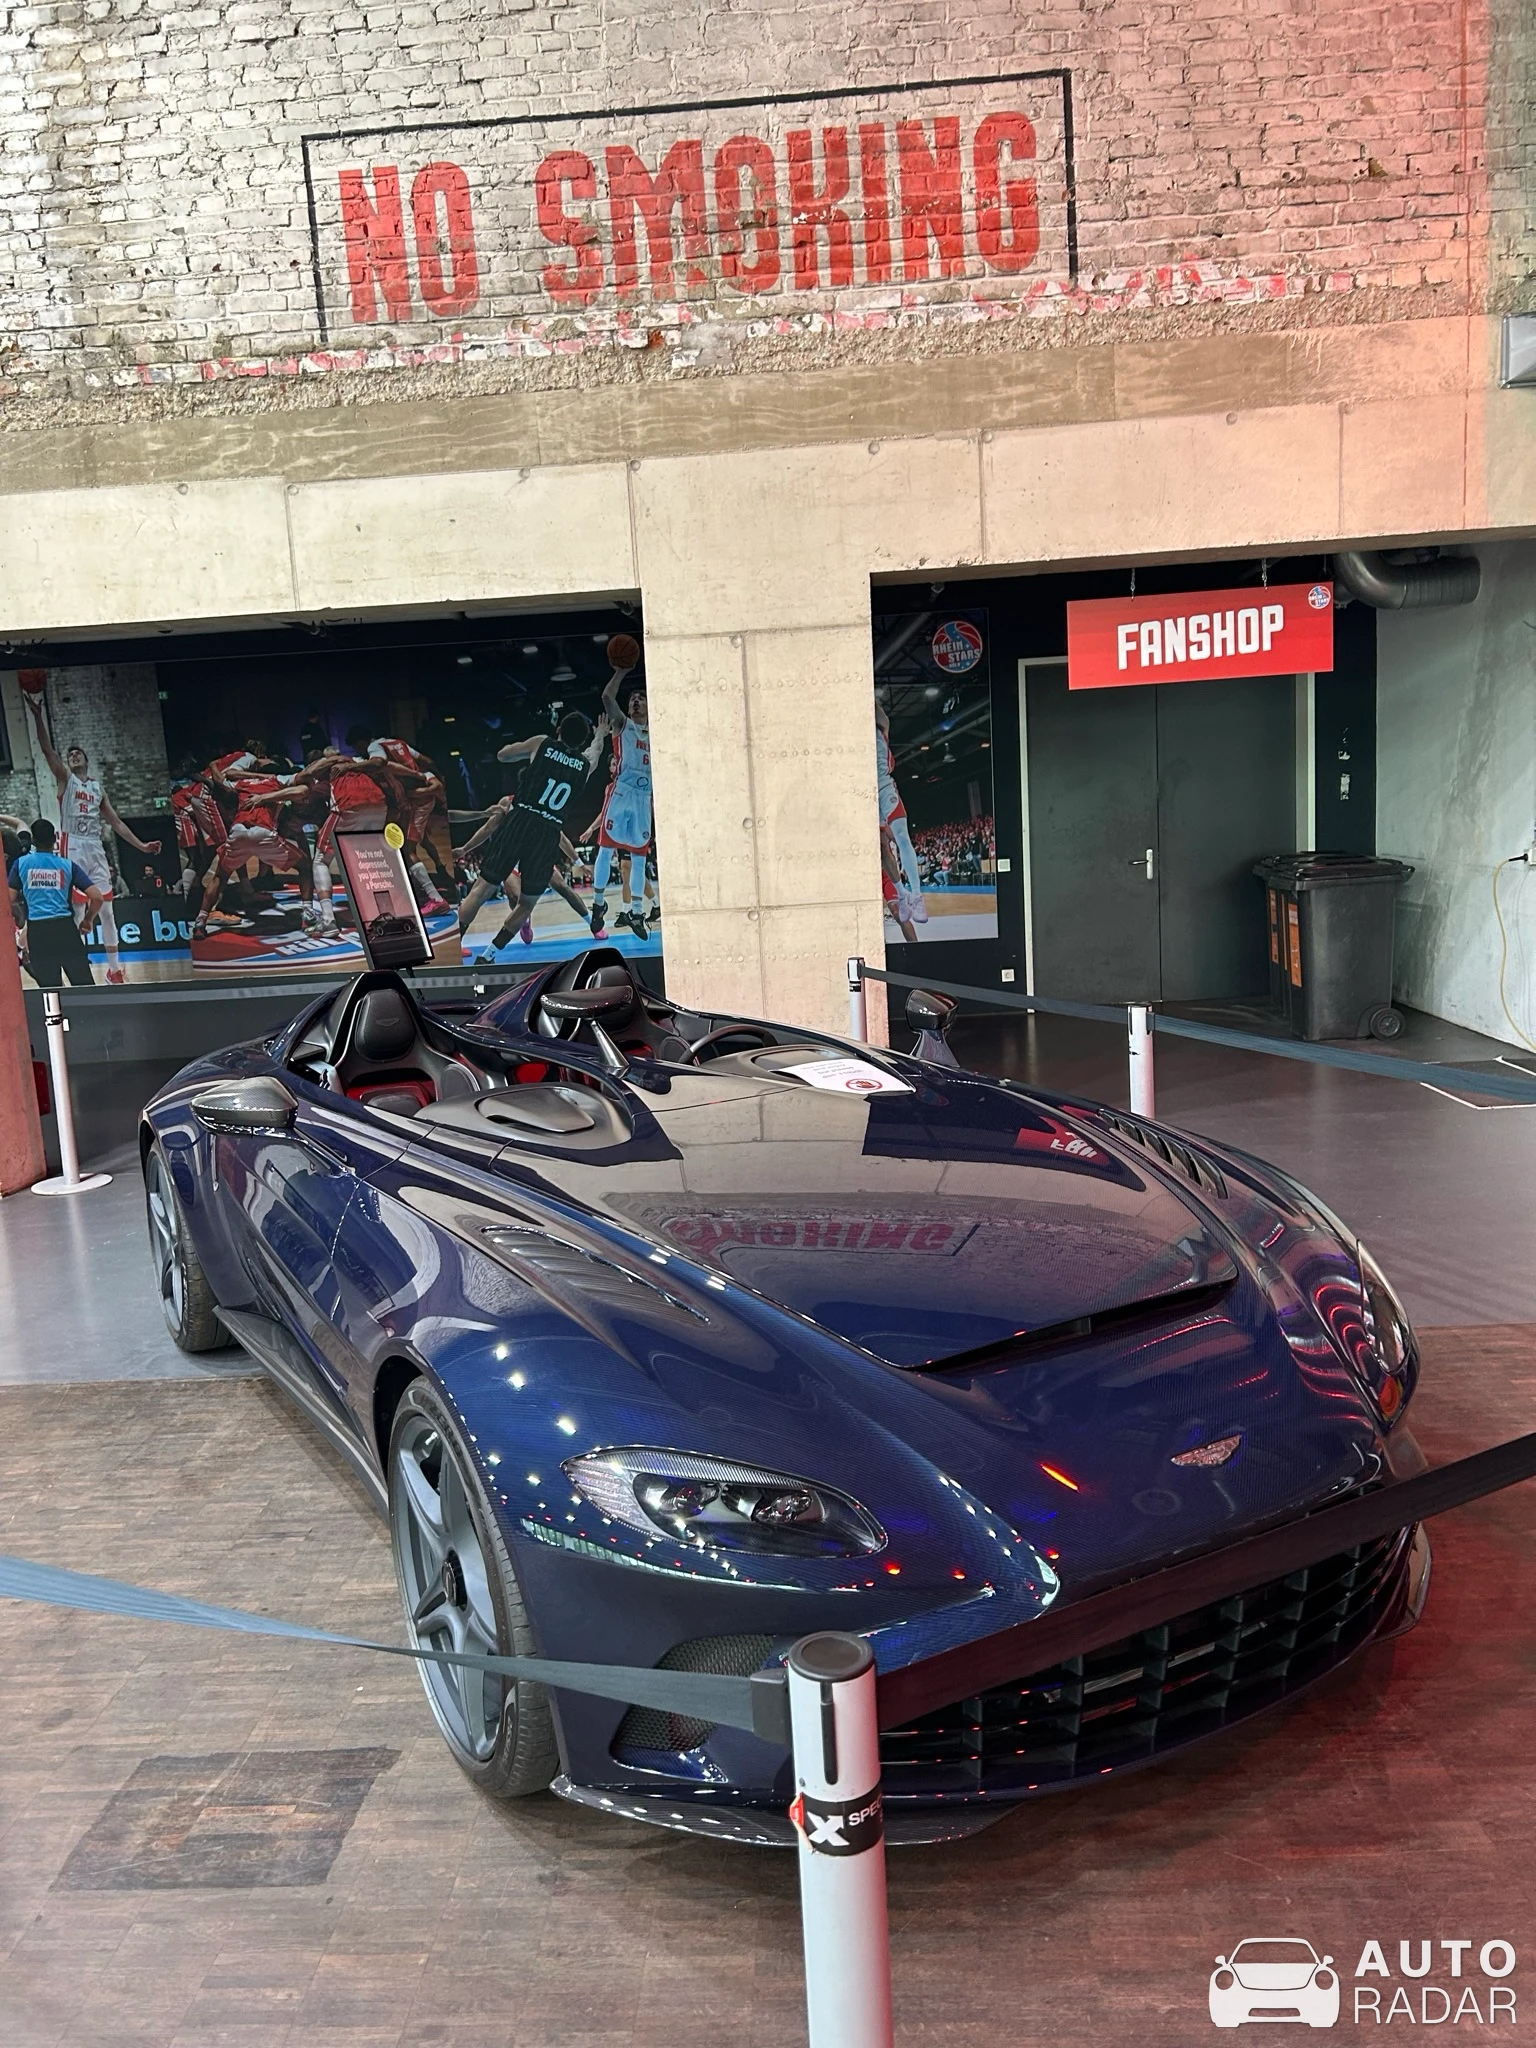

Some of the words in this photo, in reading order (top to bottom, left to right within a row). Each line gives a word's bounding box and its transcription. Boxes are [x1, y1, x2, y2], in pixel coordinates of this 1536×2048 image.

[338, 160, 480, 324] NO
[534, 110, 1041, 308] SMOKING
[932, 640, 964, 656] RHEIN
[1117, 604, 1284, 671] FANSHOP
[947, 648, 981, 663] STARS
[544, 747, 584, 771] SANDERS
[537, 778, 572, 811] 10
[374, 849, 384, 858] not
